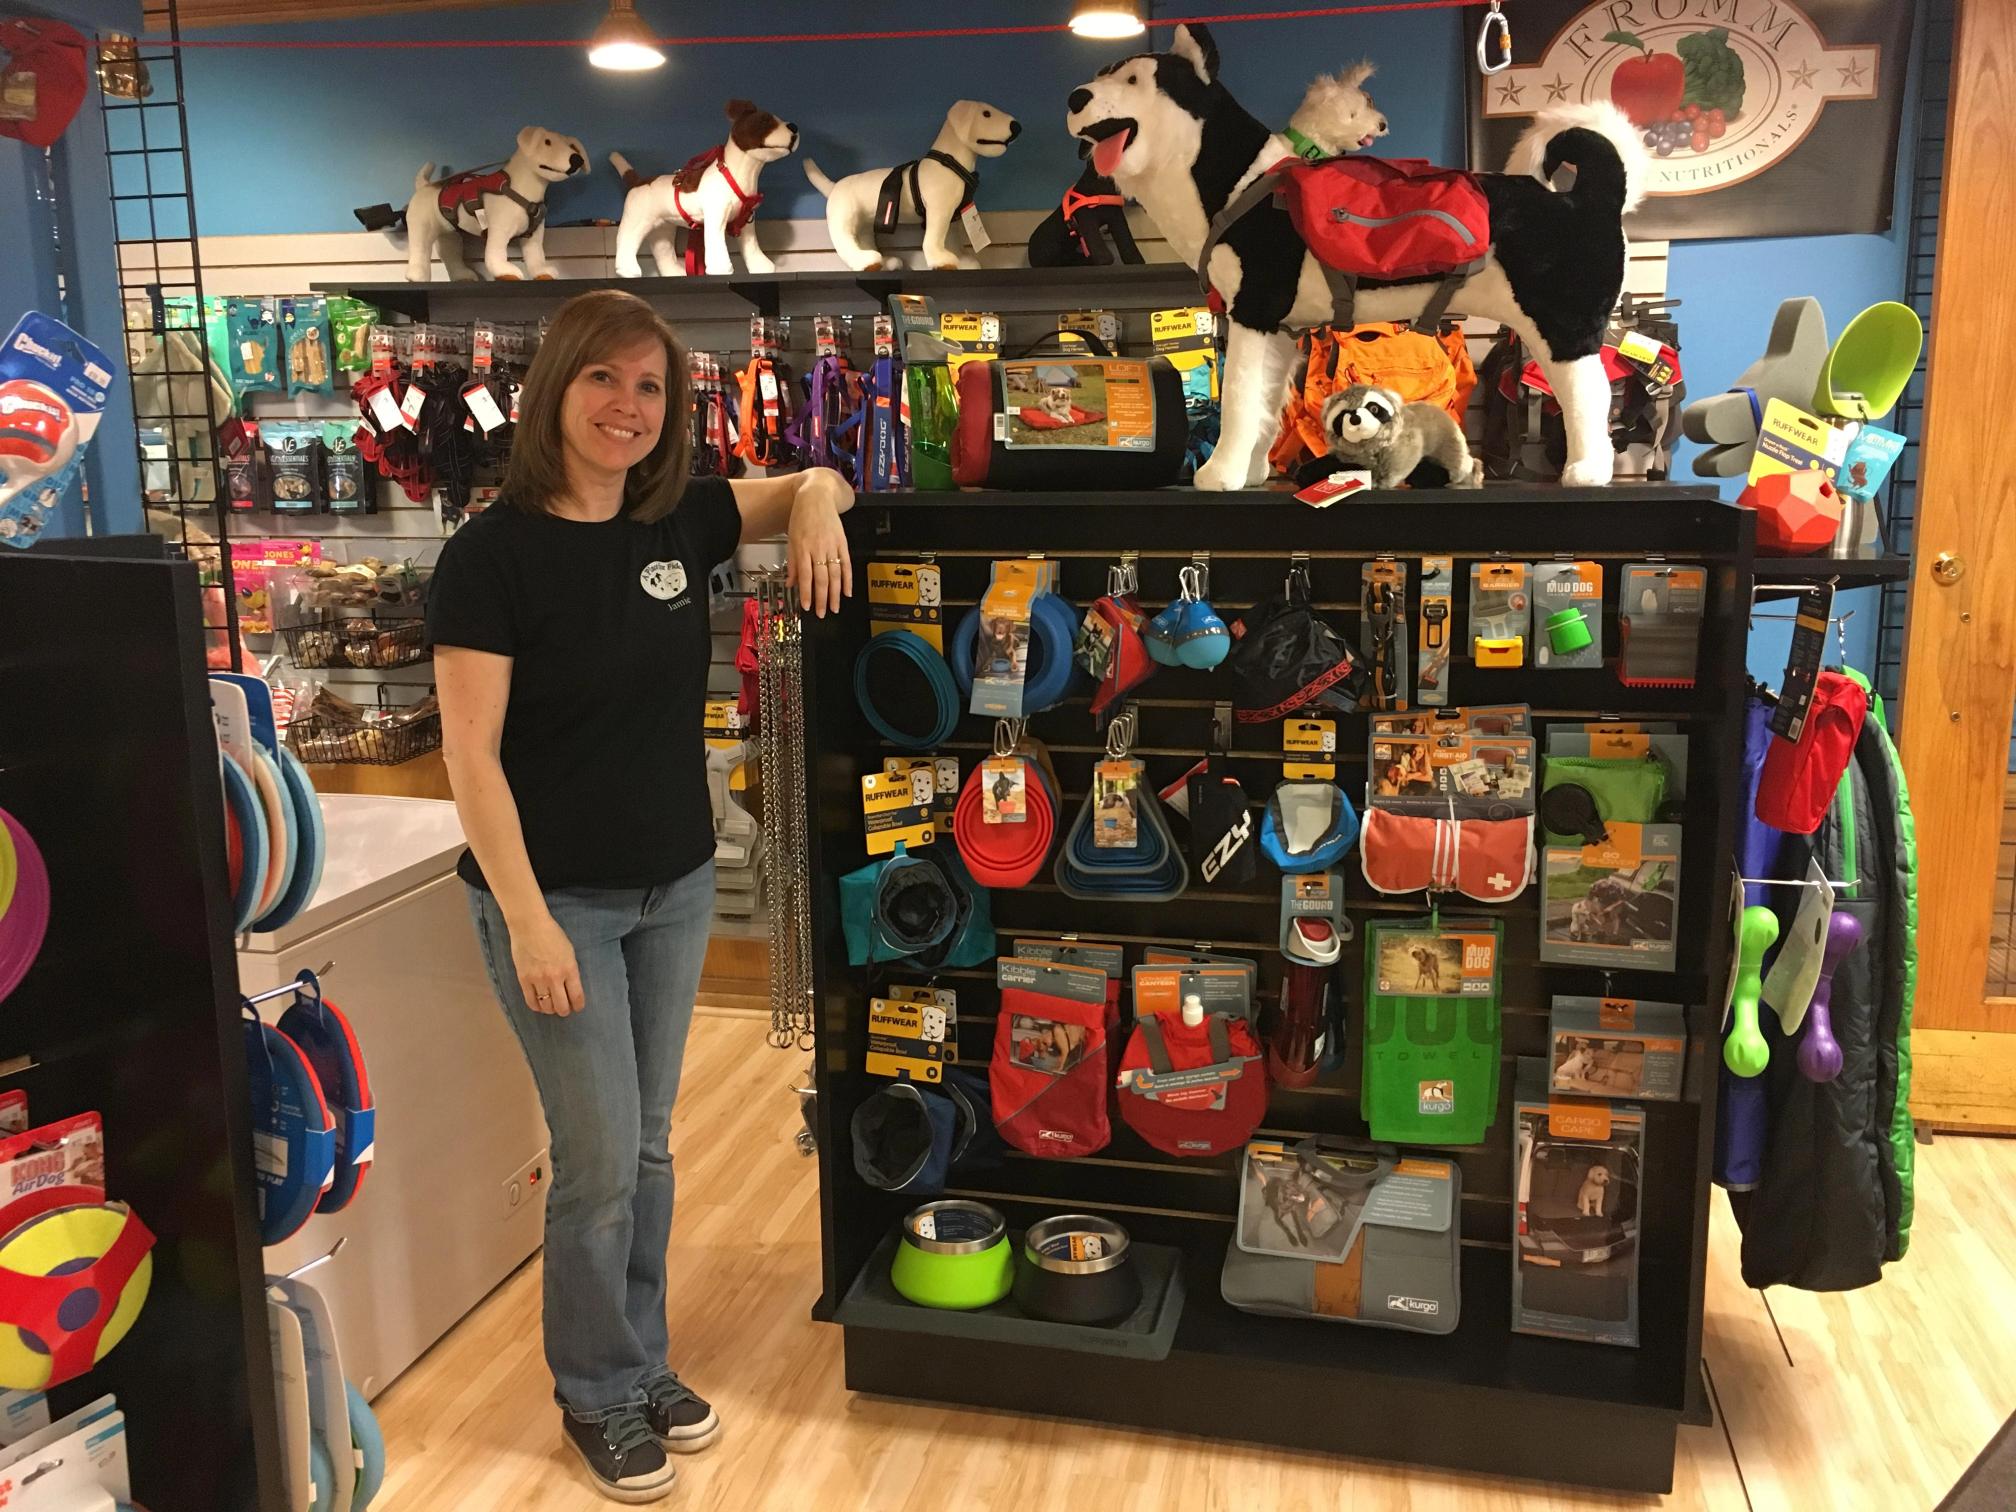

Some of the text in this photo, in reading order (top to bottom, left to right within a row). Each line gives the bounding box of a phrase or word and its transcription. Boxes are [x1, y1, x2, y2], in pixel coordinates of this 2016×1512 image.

[1563, 0, 1799, 66] FROMM
[943, 324, 978, 332] RUFFWEAR
[1154, 322, 1192, 334] RUFFWEAR
[1772, 417, 1819, 446] RUFFWEAR
[879, 417, 888, 478] EZYDOG
[264, 551, 295, 559] JONES
[871, 579, 914, 590] RUFFWEAR
[1546, 579, 1594, 593] MUD DOG
[1454, 752, 1468, 760] AID
[865, 788, 909, 802] RUFFWEAR
[1302, 899, 1333, 911] GOURD
[1017, 946, 1053, 955] Kibble
[1466, 943, 1491, 957] MUD
[1465, 957, 1490, 969] DOG
[1001, 964, 1036, 976] Kibble
[1001, 975, 1037, 985] carrier
[871, 1014, 918, 1028] RUFFWEAR
[1423, 1100, 1451, 1113] kurgo
[1554, 1115, 1601, 1127] CARGO
[1560, 1125, 1596, 1137] CAPE
[10, 1151, 65, 1187] KONG
[1409, 1301, 1437, 1313] kurgo
